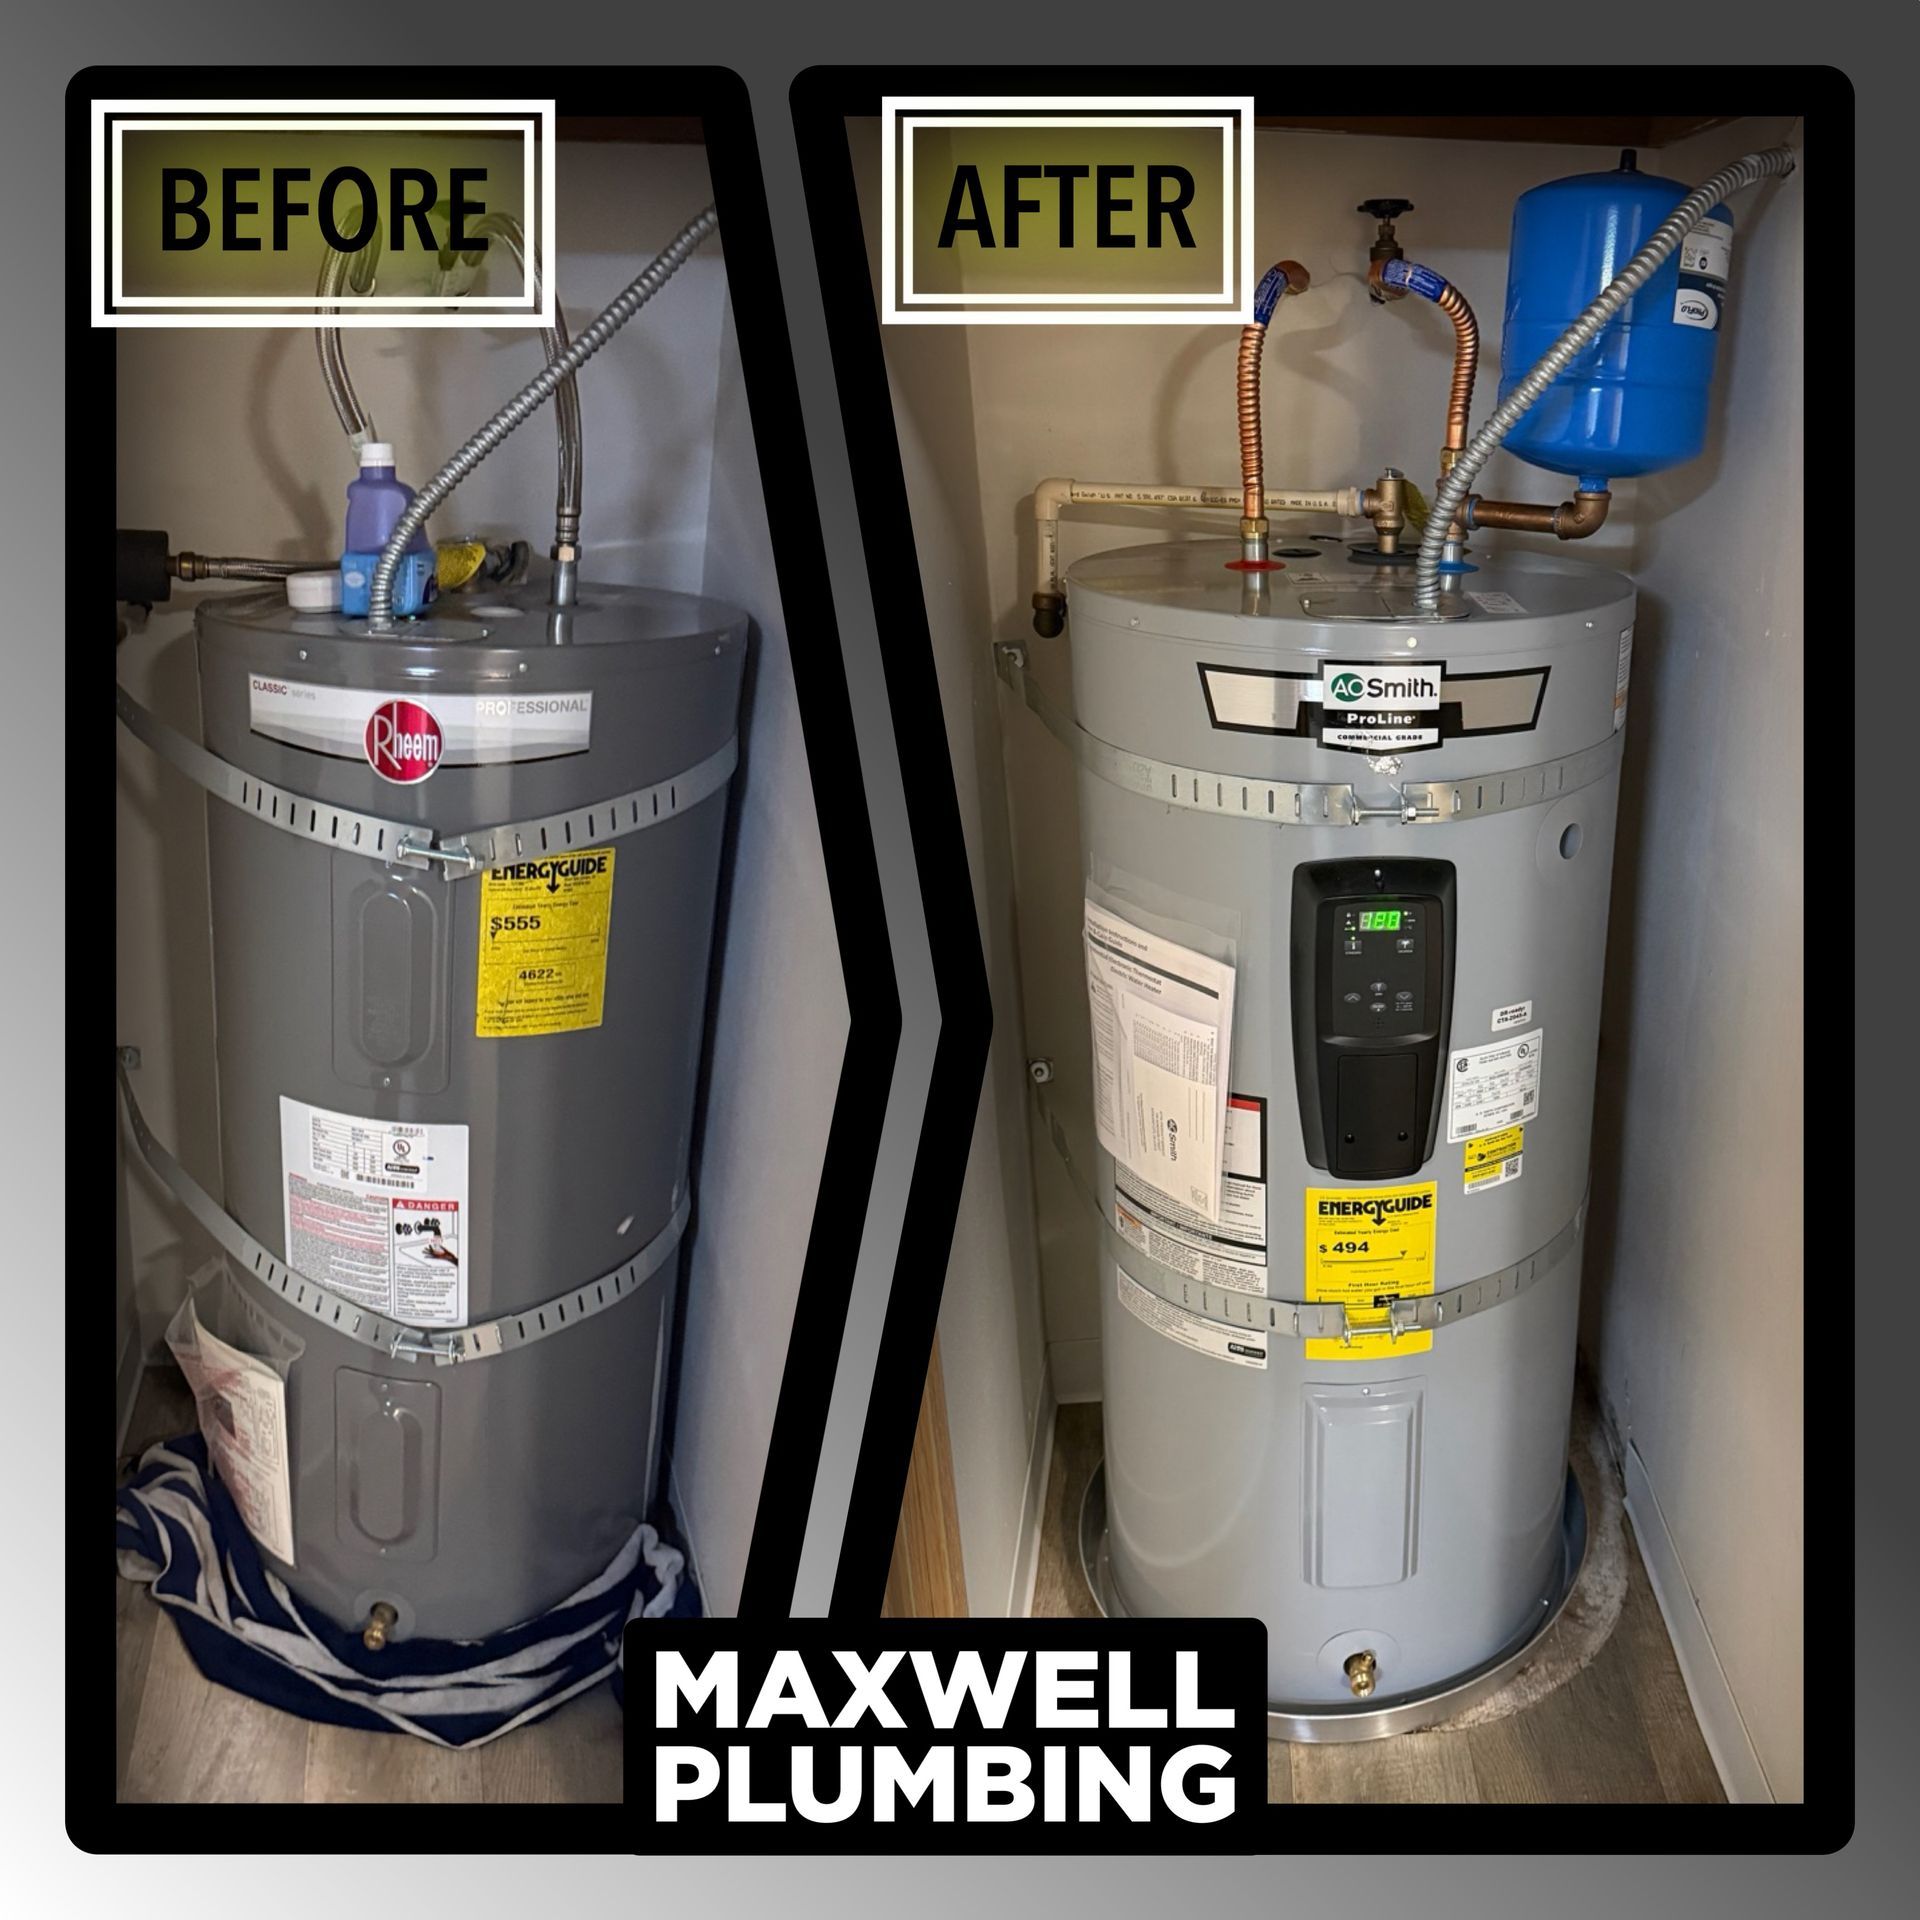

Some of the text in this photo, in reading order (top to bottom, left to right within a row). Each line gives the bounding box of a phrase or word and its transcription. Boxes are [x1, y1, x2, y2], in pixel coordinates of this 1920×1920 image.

[252, 679, 288, 696] CLASSIC
[475, 699, 588, 717] PROFESSIONAL
[1346, 712, 1413, 725] ProLine
[372, 702, 438, 771] Rheem
[490, 914, 541, 932] $555
[518, 968, 555, 980] 4622
[407, 1200, 456, 1211] DANGER
[1318, 1193, 1433, 1217] ENERGYGUIDE
[1332, 1241, 1370, 1254] 494
